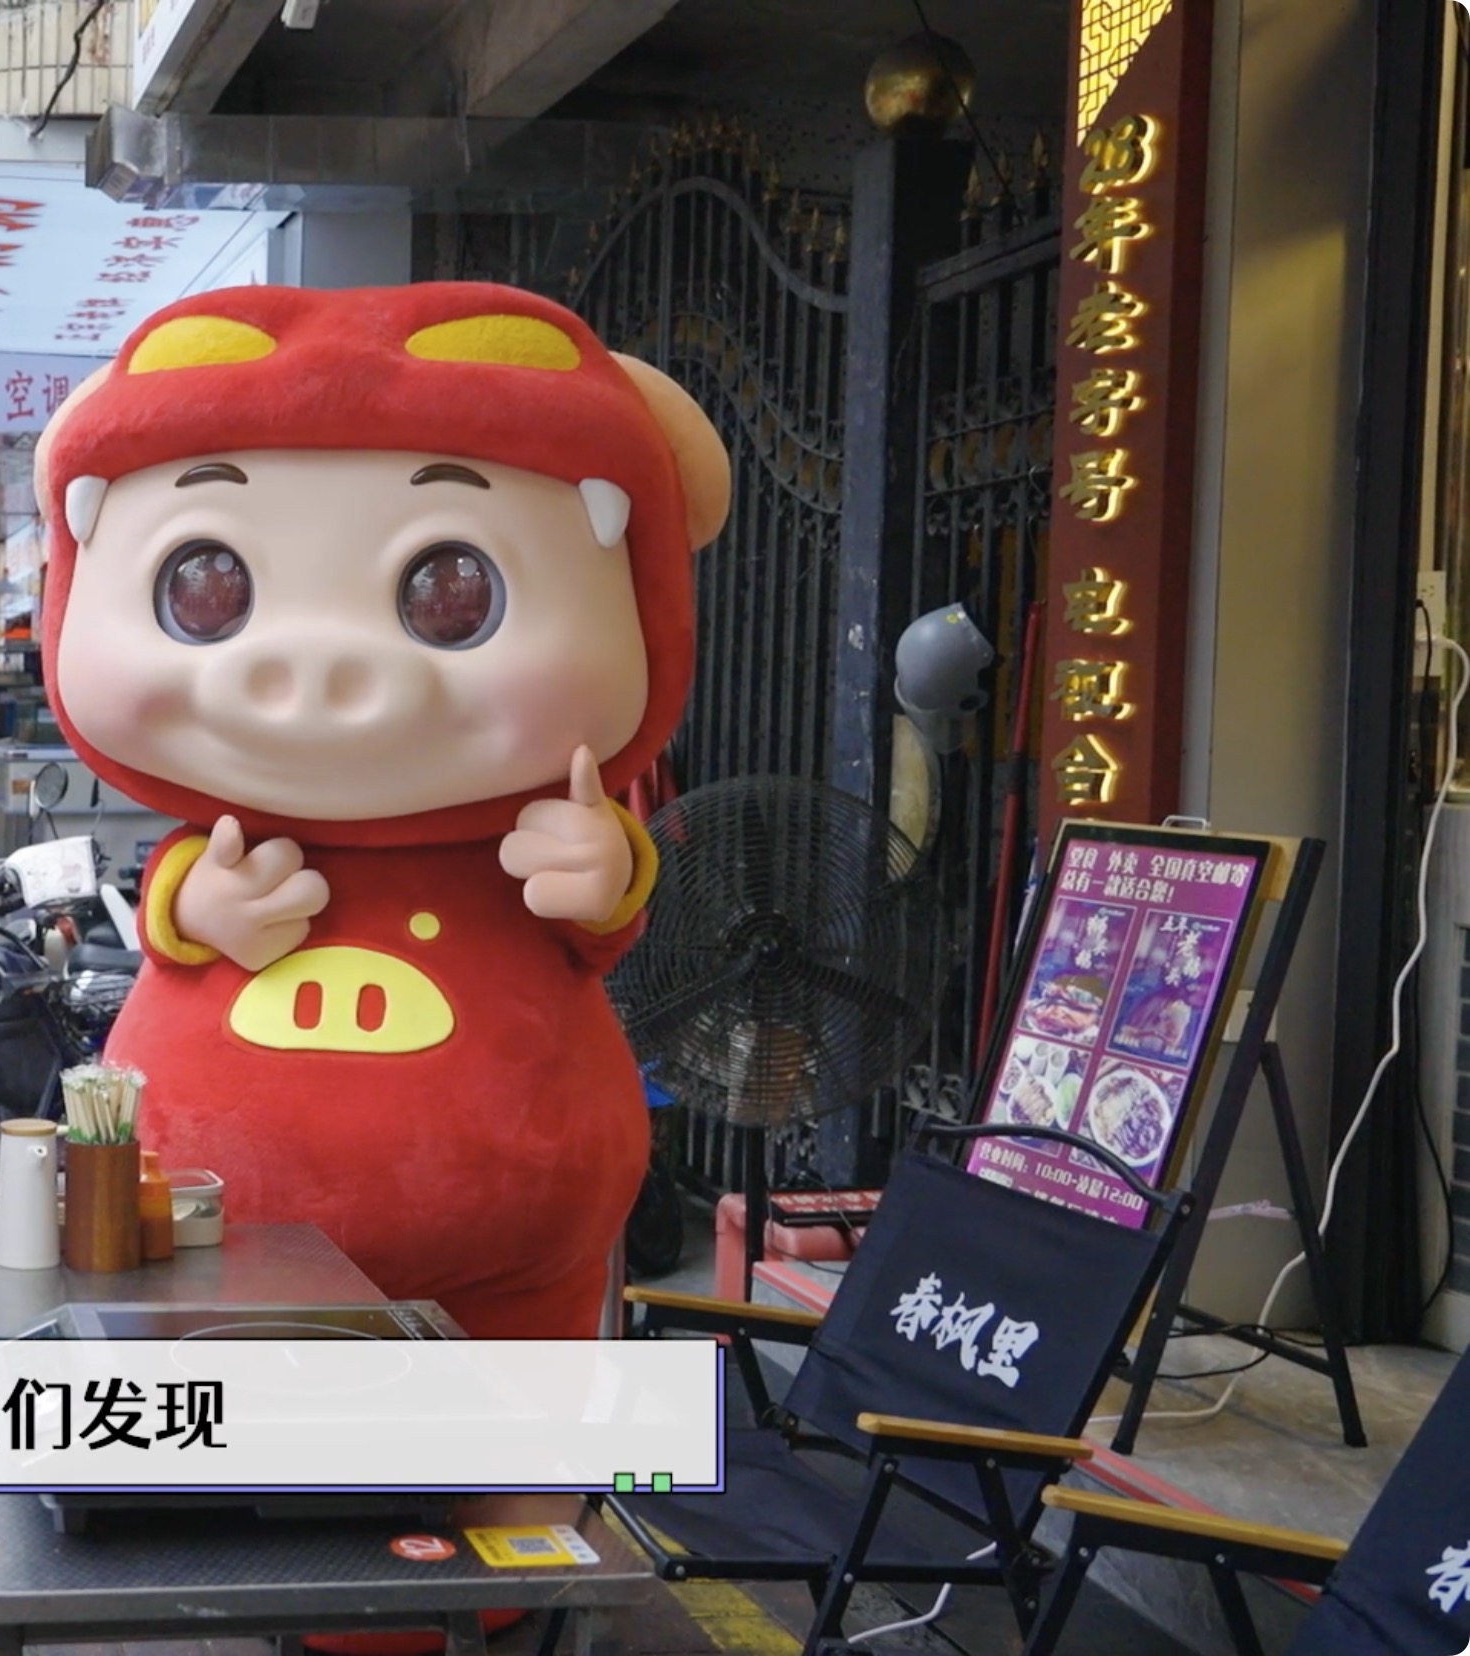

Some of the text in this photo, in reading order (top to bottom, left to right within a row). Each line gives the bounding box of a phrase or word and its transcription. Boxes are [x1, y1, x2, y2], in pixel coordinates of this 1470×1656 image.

[4, 370, 86, 422] 空调
[1107, 851, 1139, 875] 外卖
[1148, 855, 1250, 887] 全国真空邮寄
[890, 1272, 1039, 1388] 春枫里
